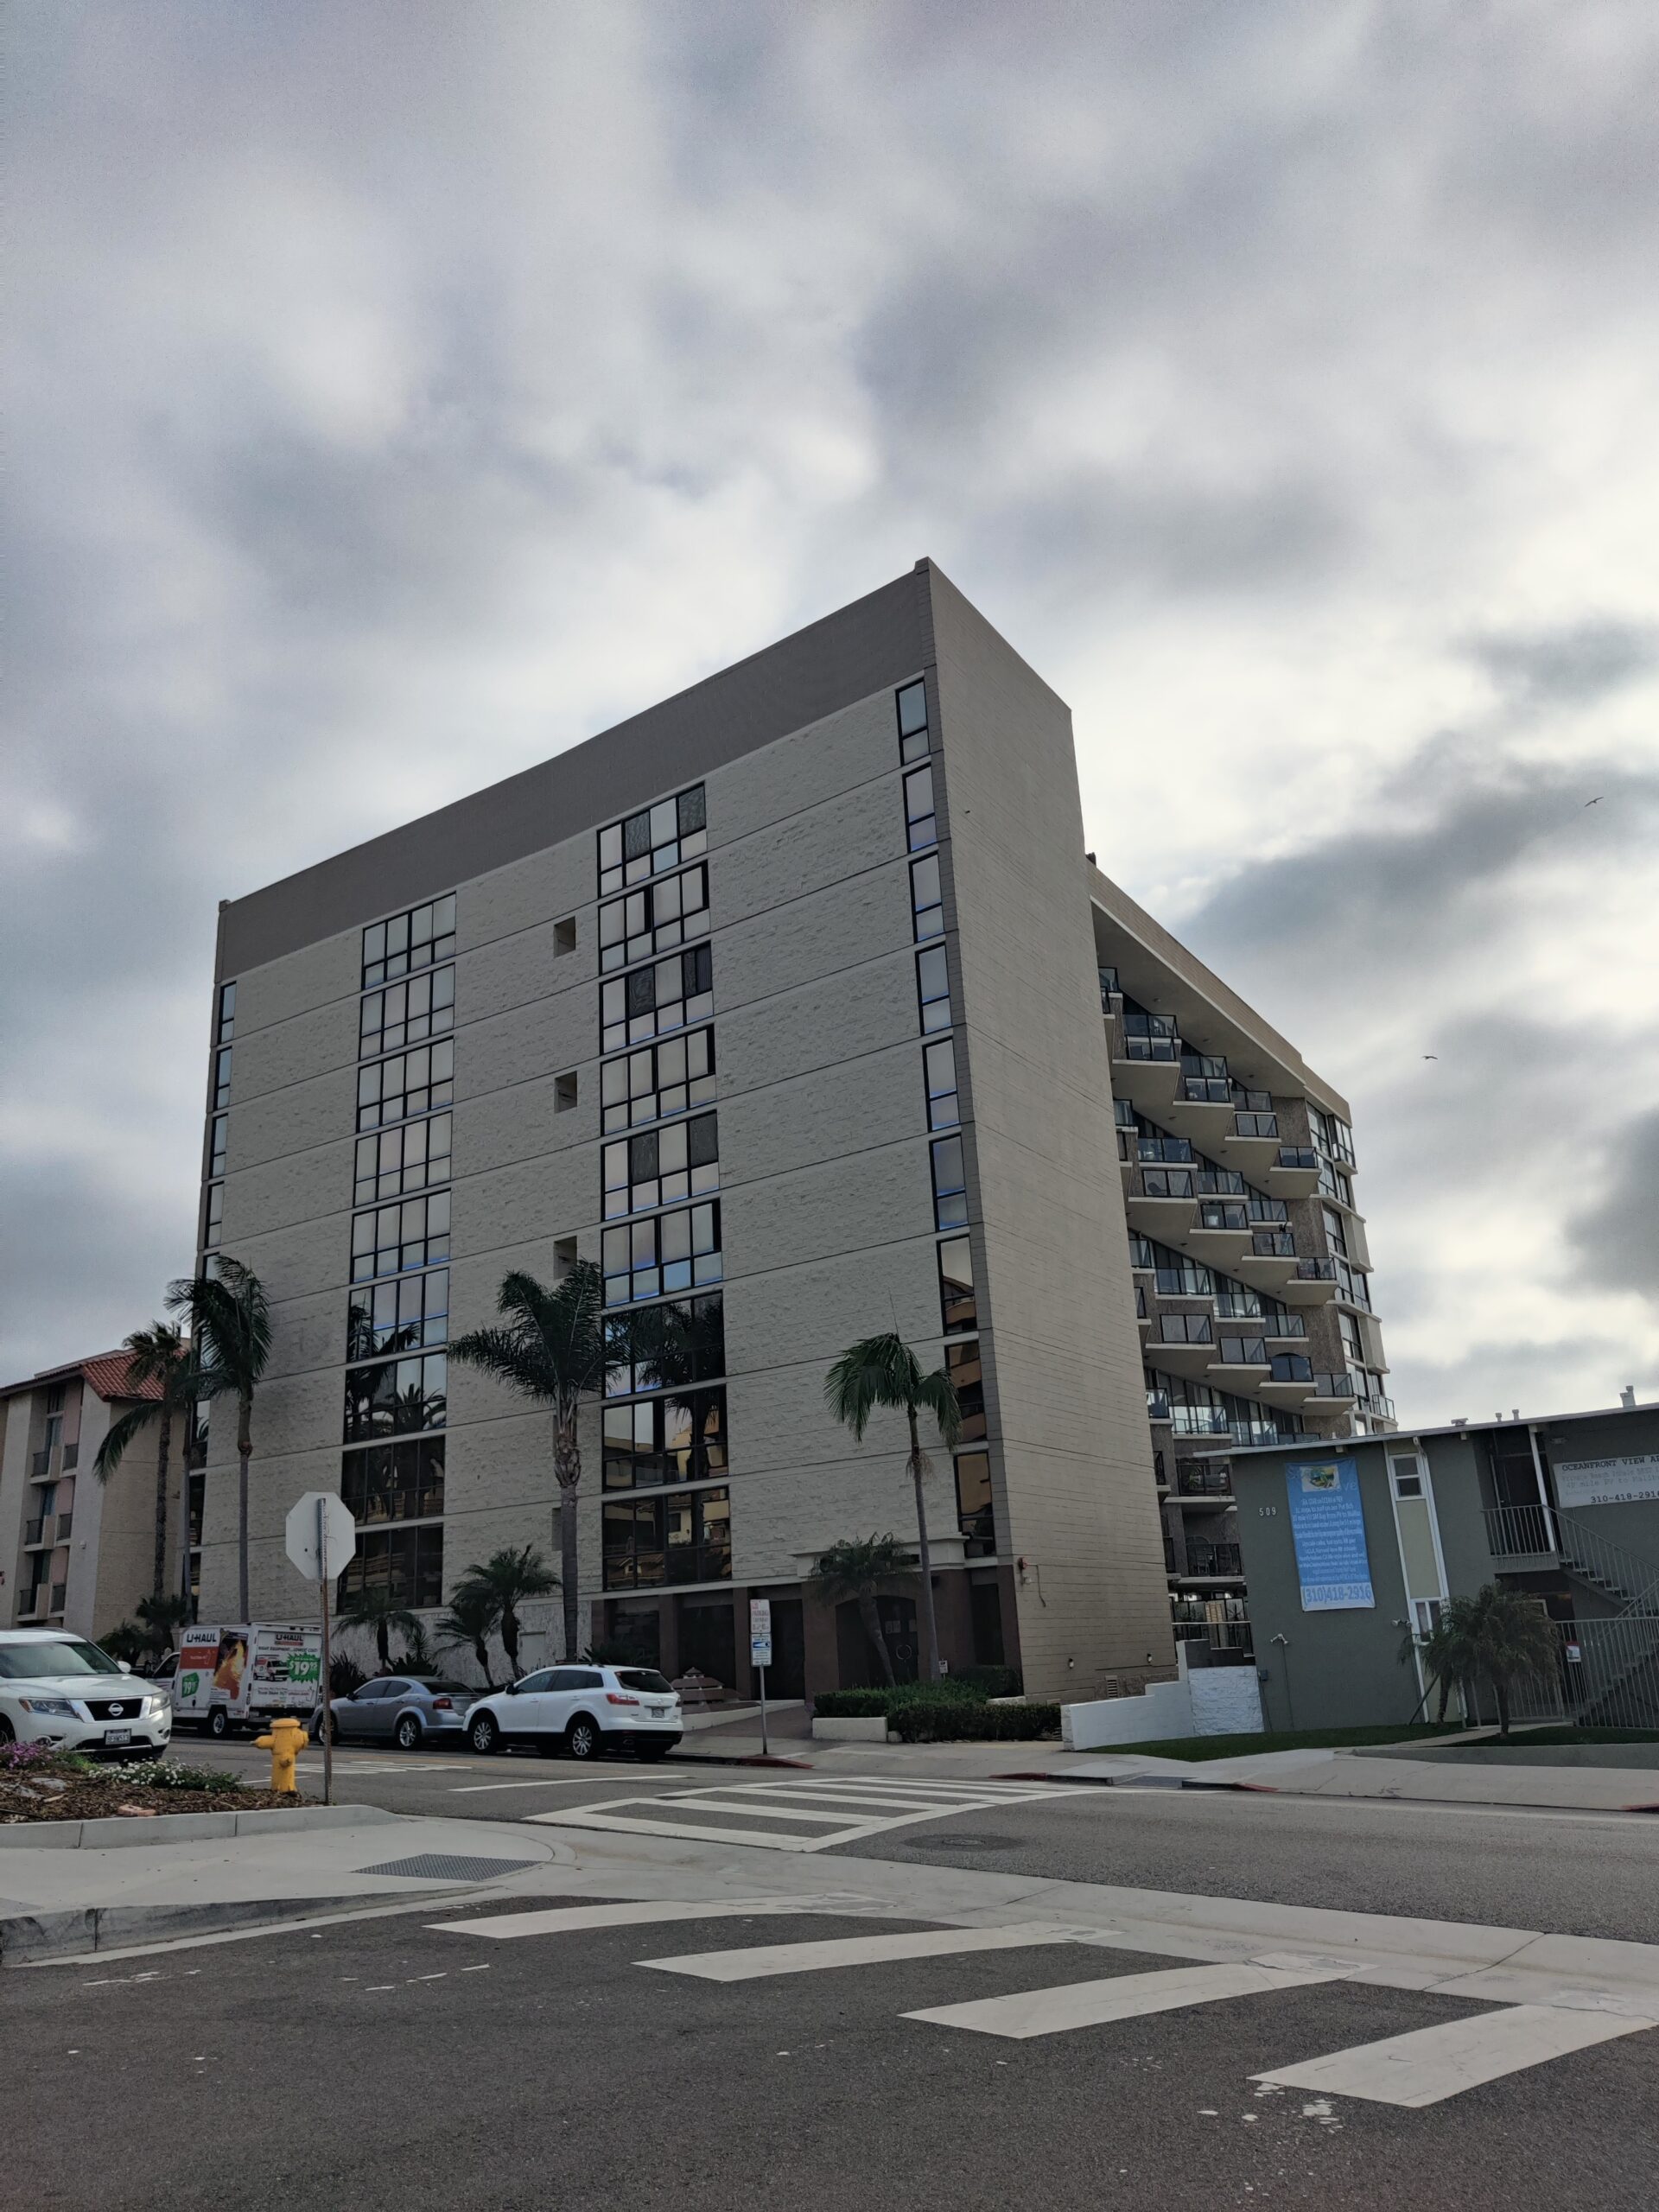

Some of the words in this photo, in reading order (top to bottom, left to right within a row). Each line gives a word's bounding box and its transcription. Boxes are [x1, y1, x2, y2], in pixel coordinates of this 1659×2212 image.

[1562, 1460, 1617, 1471] OCEANFRONT
[1622, 1457, 1645, 1465] VIEW
[1259, 1506, 1276, 1516] 509
[1303, 1585, 1371, 1605] (310)418-2916
[187, 1633, 217, 1643] U-HAUL
[276, 1633, 304, 1642] U-HAUL
